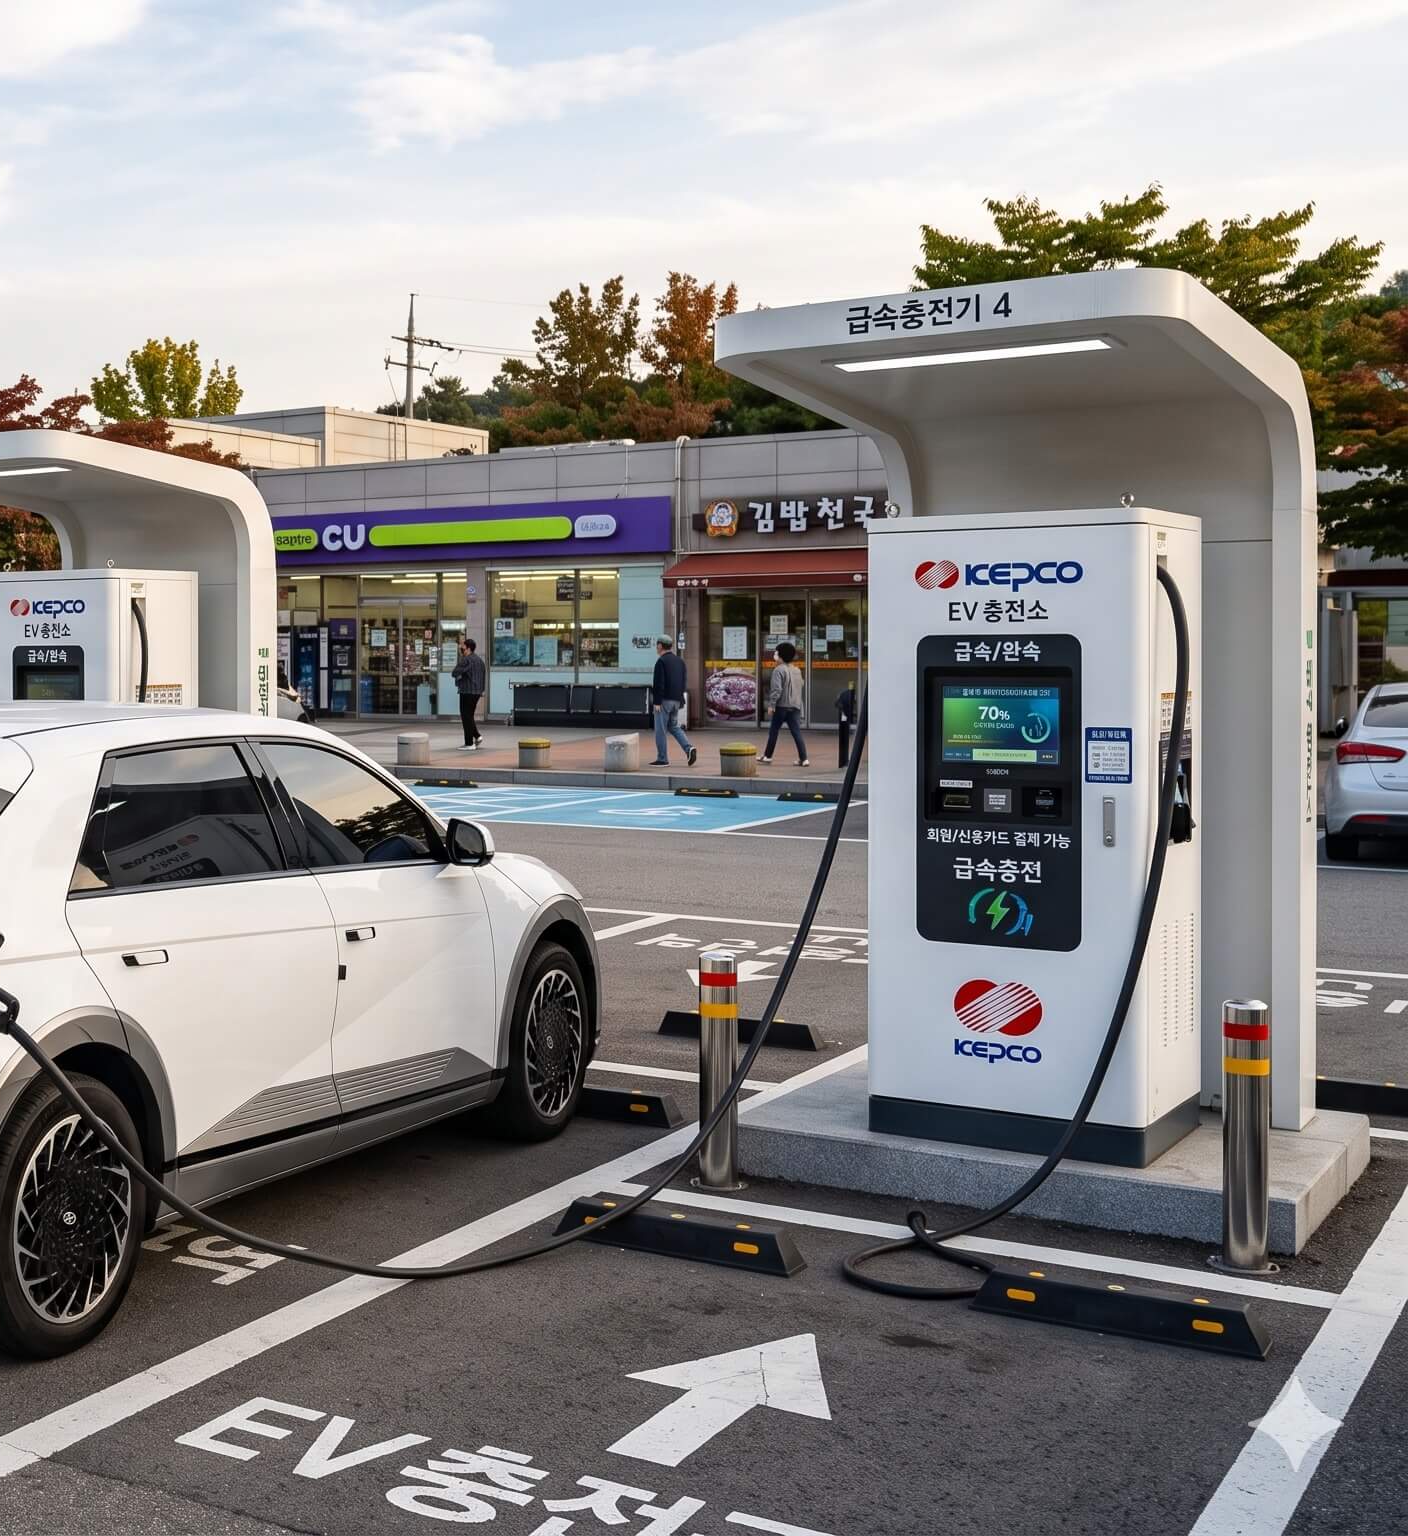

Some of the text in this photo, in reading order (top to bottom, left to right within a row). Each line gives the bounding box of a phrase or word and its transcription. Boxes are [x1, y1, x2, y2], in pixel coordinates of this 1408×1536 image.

[846, 292, 1012, 335] 급속충전기 4
[748, 496, 874, 534] 김밥천국
[322, 524, 365, 551] CU
[965, 561, 1084, 592] KEPCO
[32, 599, 86, 619] KEPCO
[948, 599, 1049, 623] EV 충전소
[24, 624, 39, 638] EV
[954, 641, 1042, 662] 급속/완속
[1044, 833, 1072, 849] 가능
[954, 1039, 1042, 1064] KEPCO
